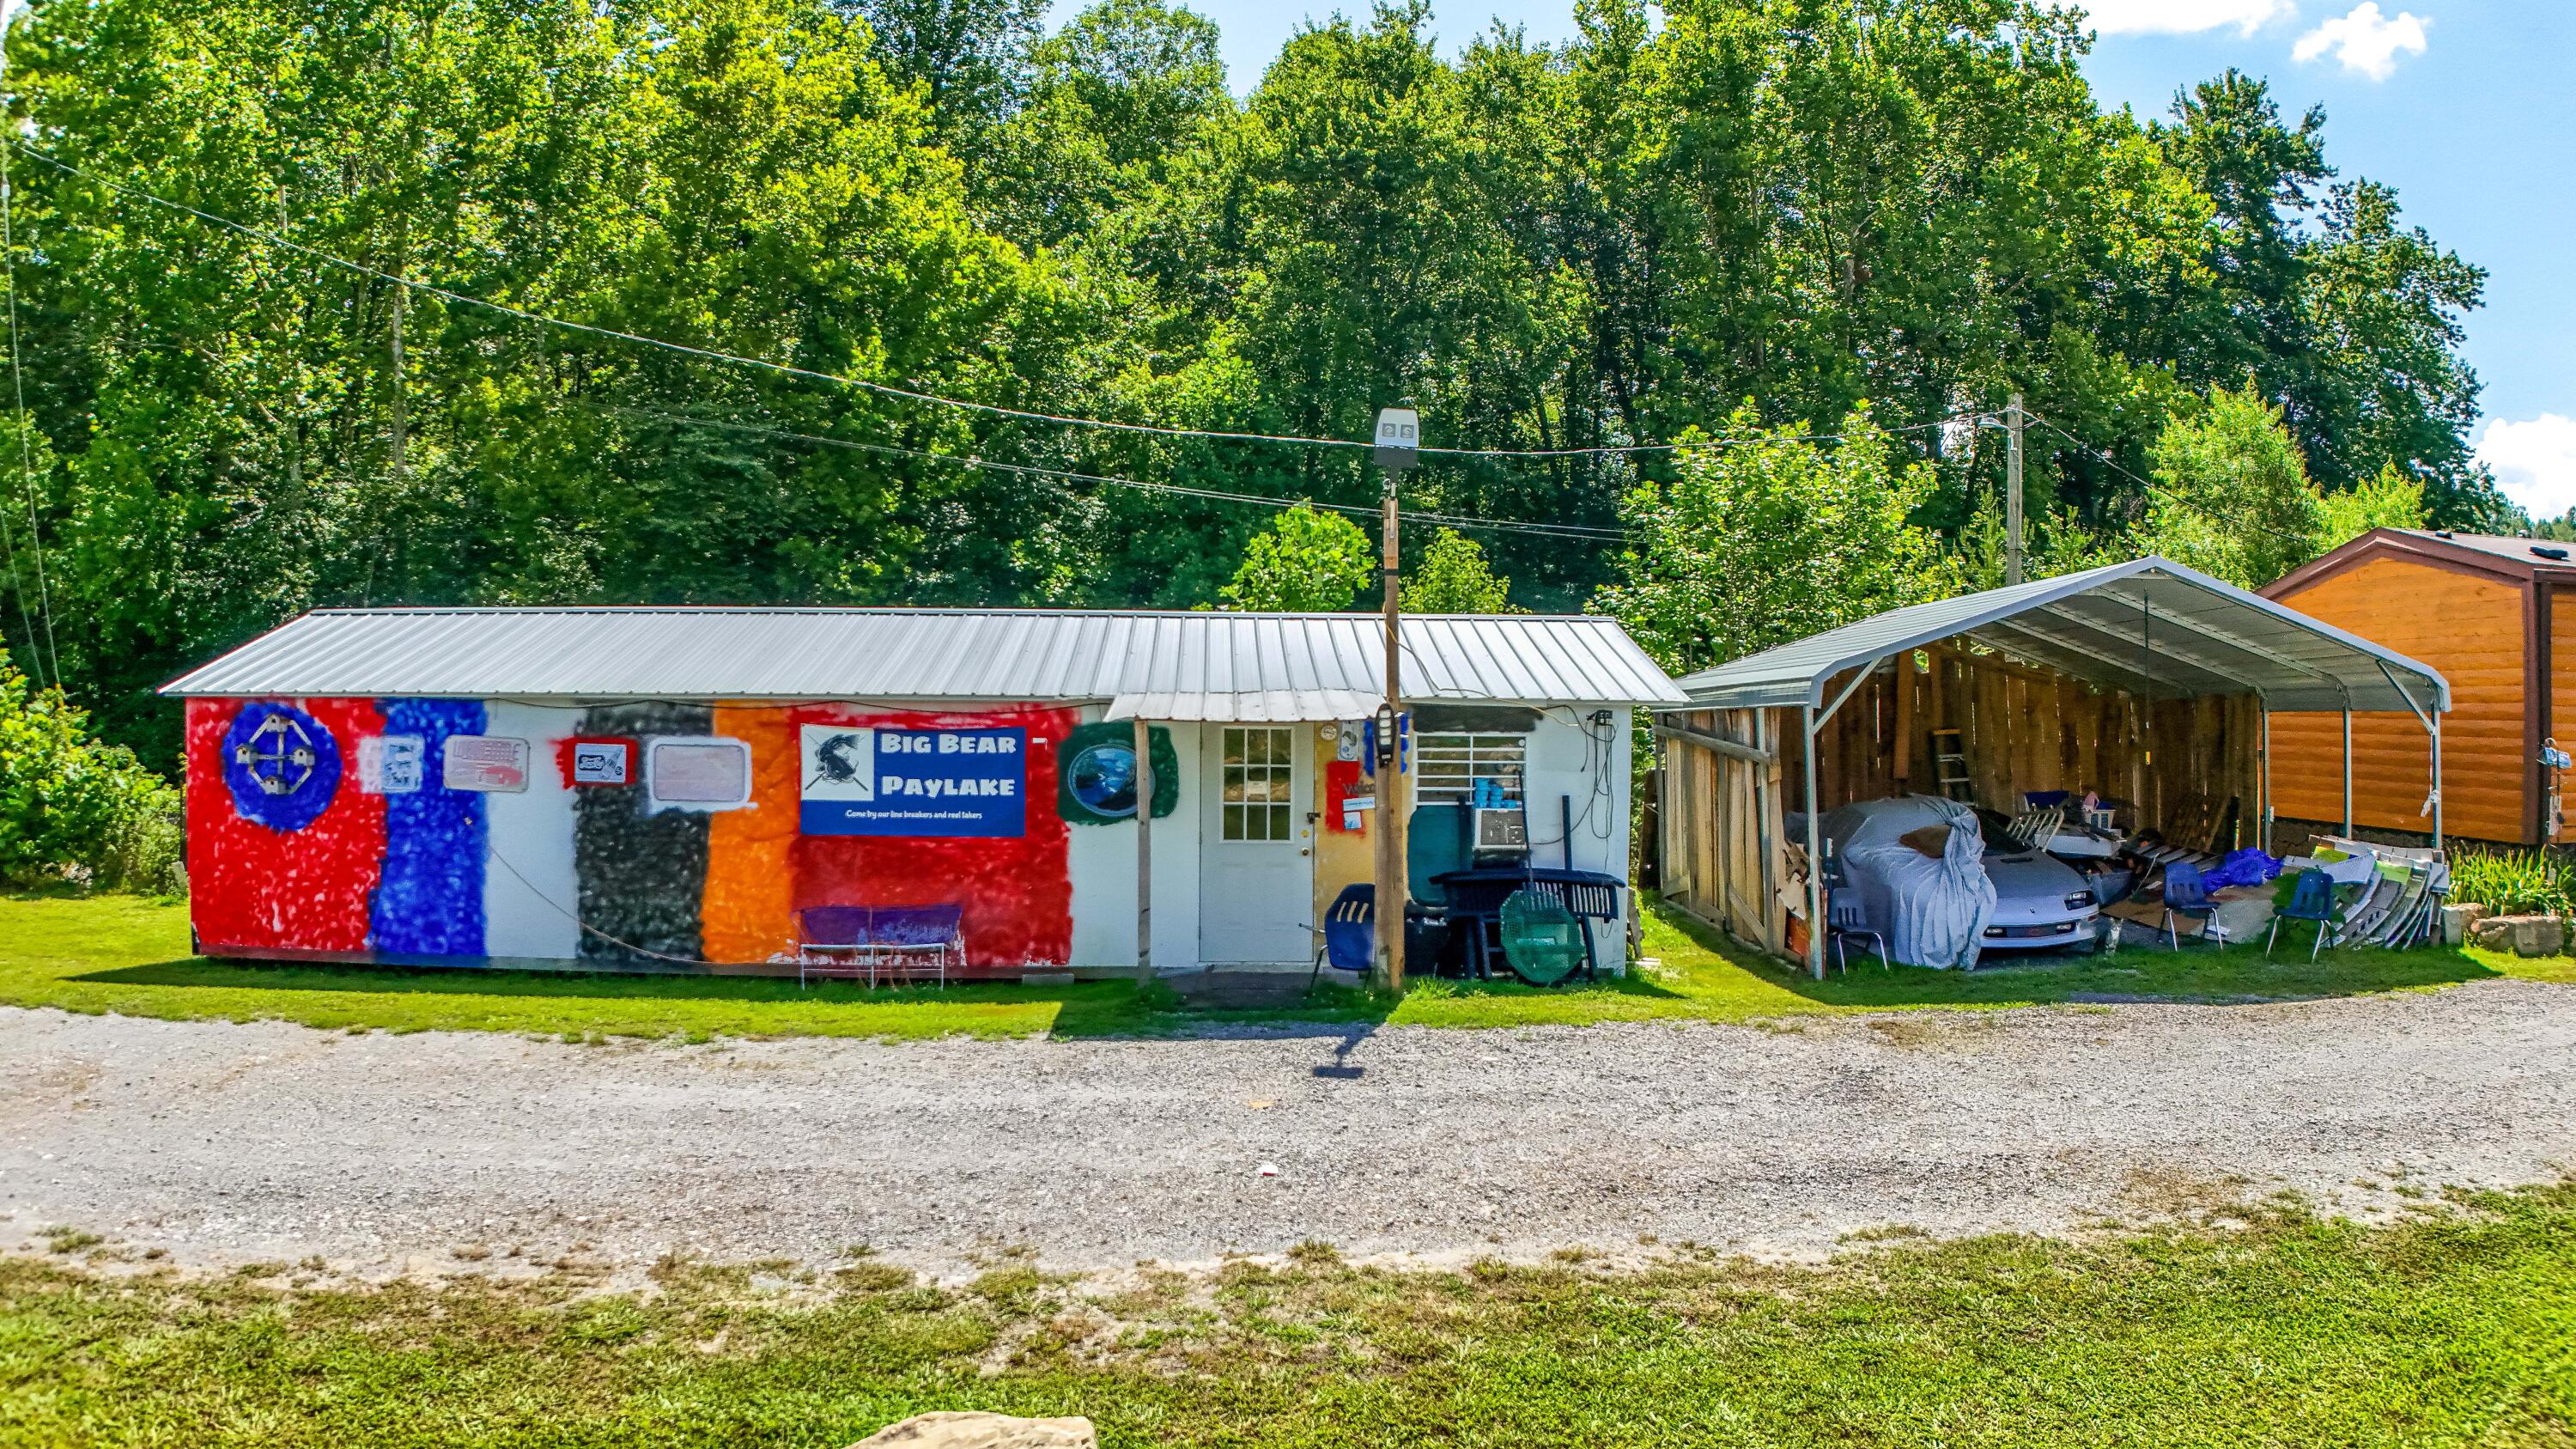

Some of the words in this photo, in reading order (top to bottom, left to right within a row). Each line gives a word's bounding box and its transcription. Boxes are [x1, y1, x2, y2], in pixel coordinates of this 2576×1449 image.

[881, 733, 931, 753] BIG
[939, 734, 1017, 754] BEAR
[881, 776, 1015, 798] PAYLAKE
[846, 809, 866, 818] Come
[866, 809, 877, 819] try
[903, 810, 933, 819] breakers
[948, 810, 961, 819] reel
[962, 810, 982, 819] takers
